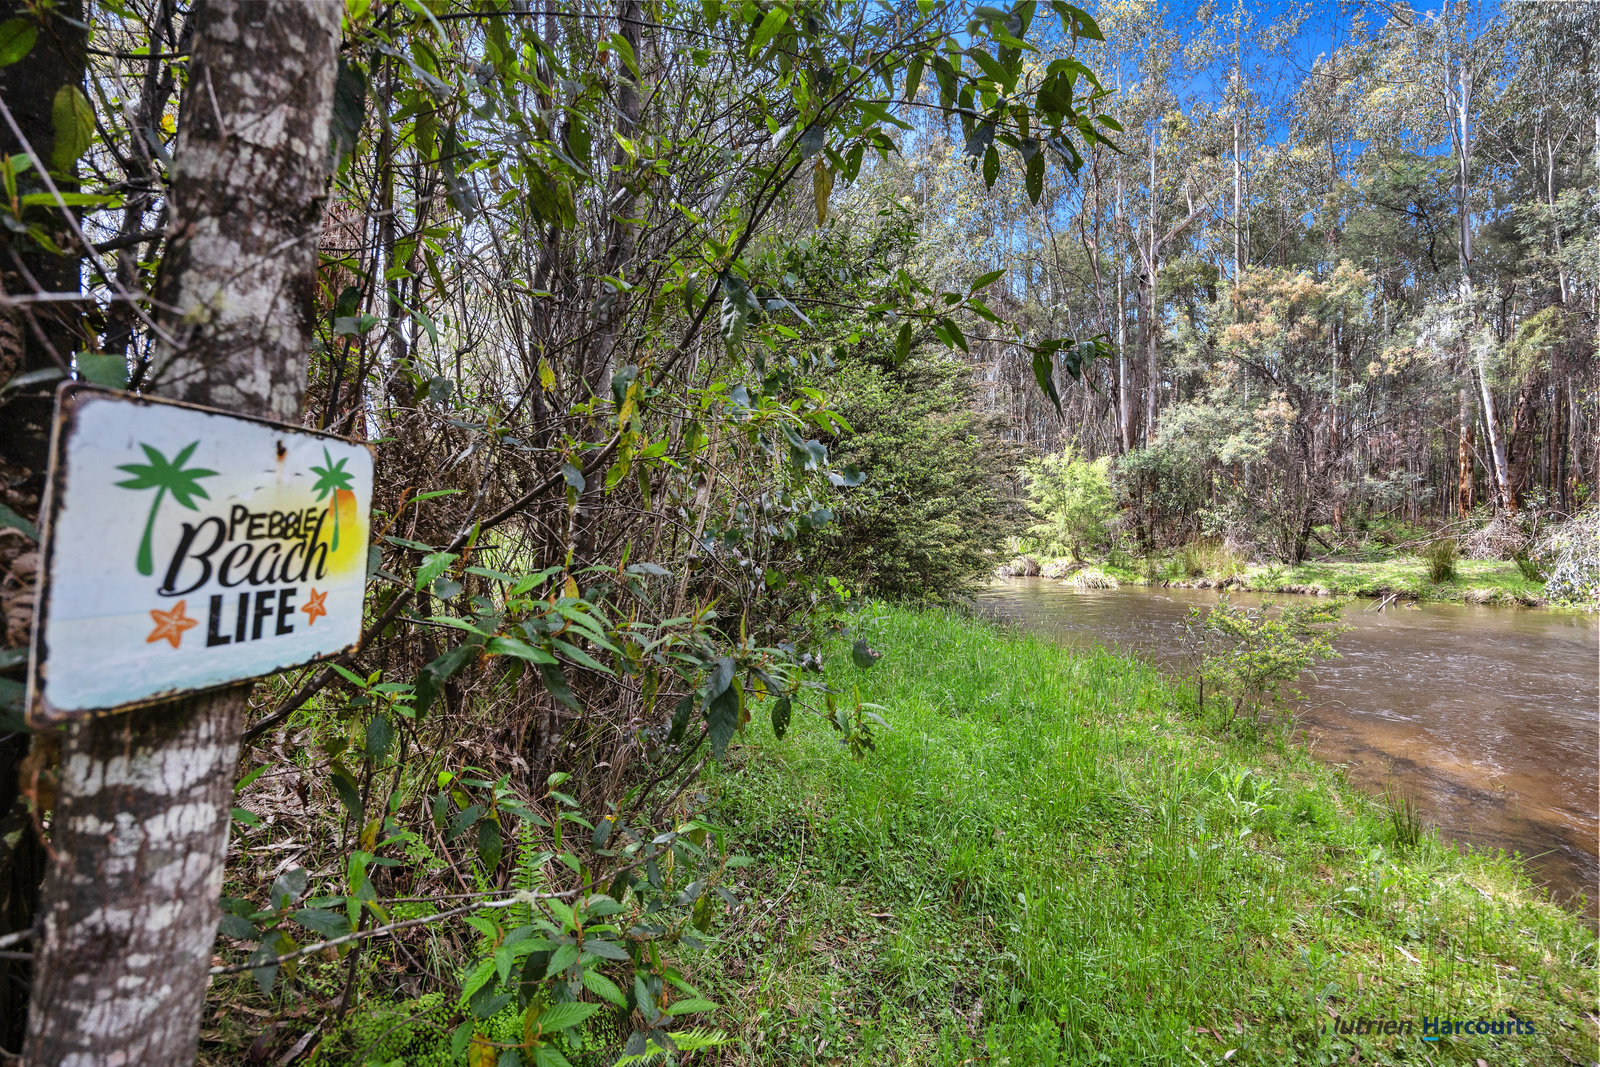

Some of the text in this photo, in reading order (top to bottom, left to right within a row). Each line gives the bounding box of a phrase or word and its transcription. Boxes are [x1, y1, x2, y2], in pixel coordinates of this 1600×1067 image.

[157, 508, 329, 597] Beach
[228, 504, 318, 541] PEBBLE
[206, 587, 297, 648] LIFE
